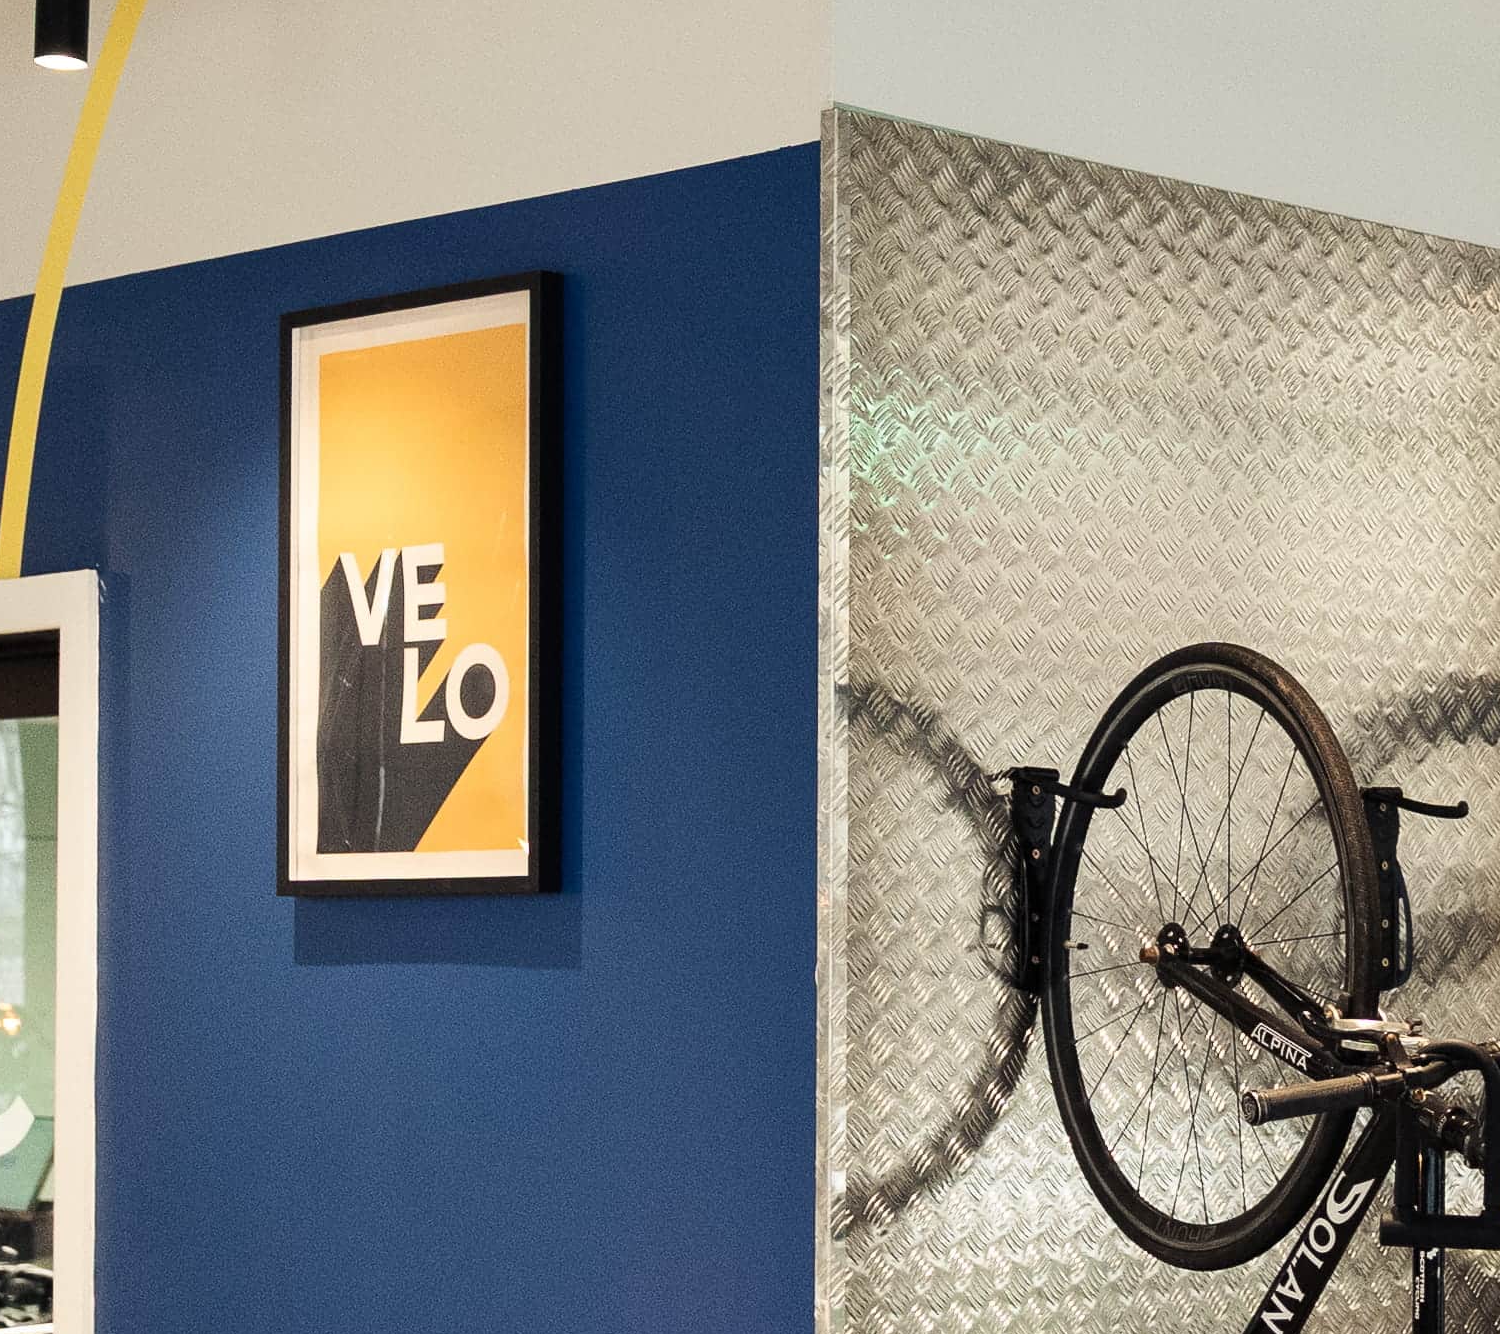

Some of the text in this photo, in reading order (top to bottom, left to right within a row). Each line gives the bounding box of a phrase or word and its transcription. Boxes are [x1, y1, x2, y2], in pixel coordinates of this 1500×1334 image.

[338, 542, 448, 647] VE
[399, 642, 510, 745] LO
[1250, 1023, 1312, 1071] ALPINA
